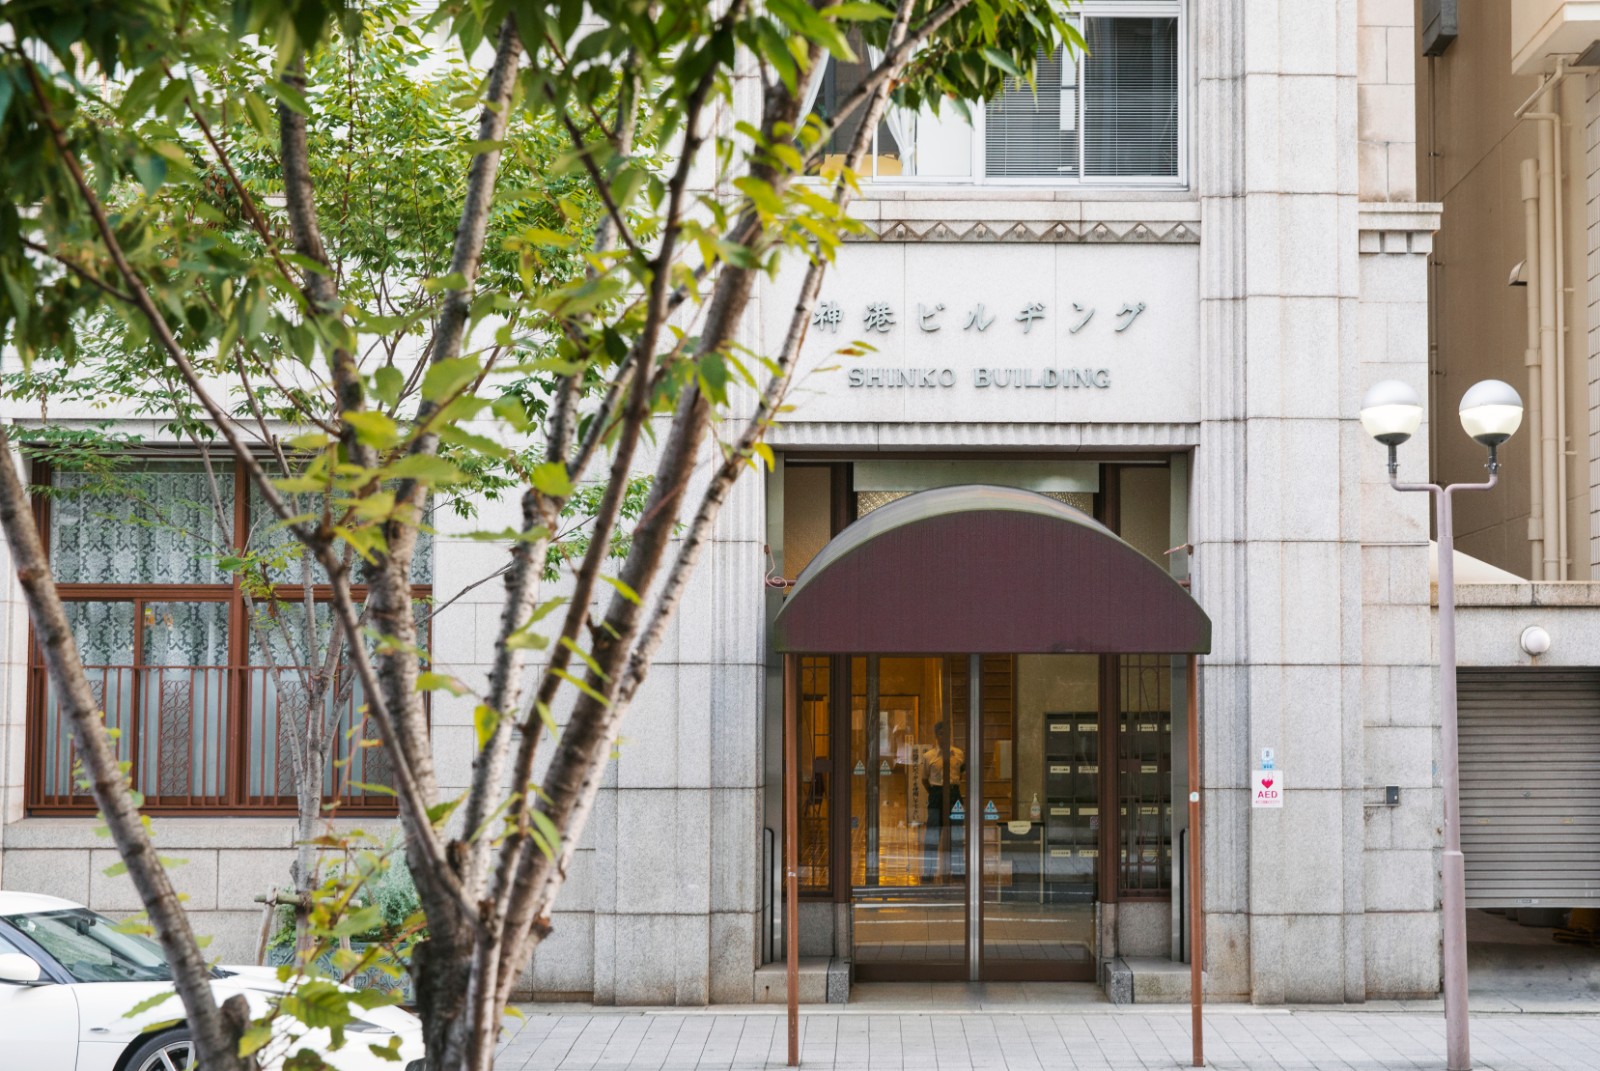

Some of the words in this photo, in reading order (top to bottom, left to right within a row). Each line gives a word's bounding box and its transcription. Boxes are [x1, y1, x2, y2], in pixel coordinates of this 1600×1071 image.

[813, 301, 1146, 333] 神港ビルヂング
[849, 368, 956, 389] SHINKO
[974, 368, 1111, 389] BUILDING
[1257, 790, 1278, 799] AED
